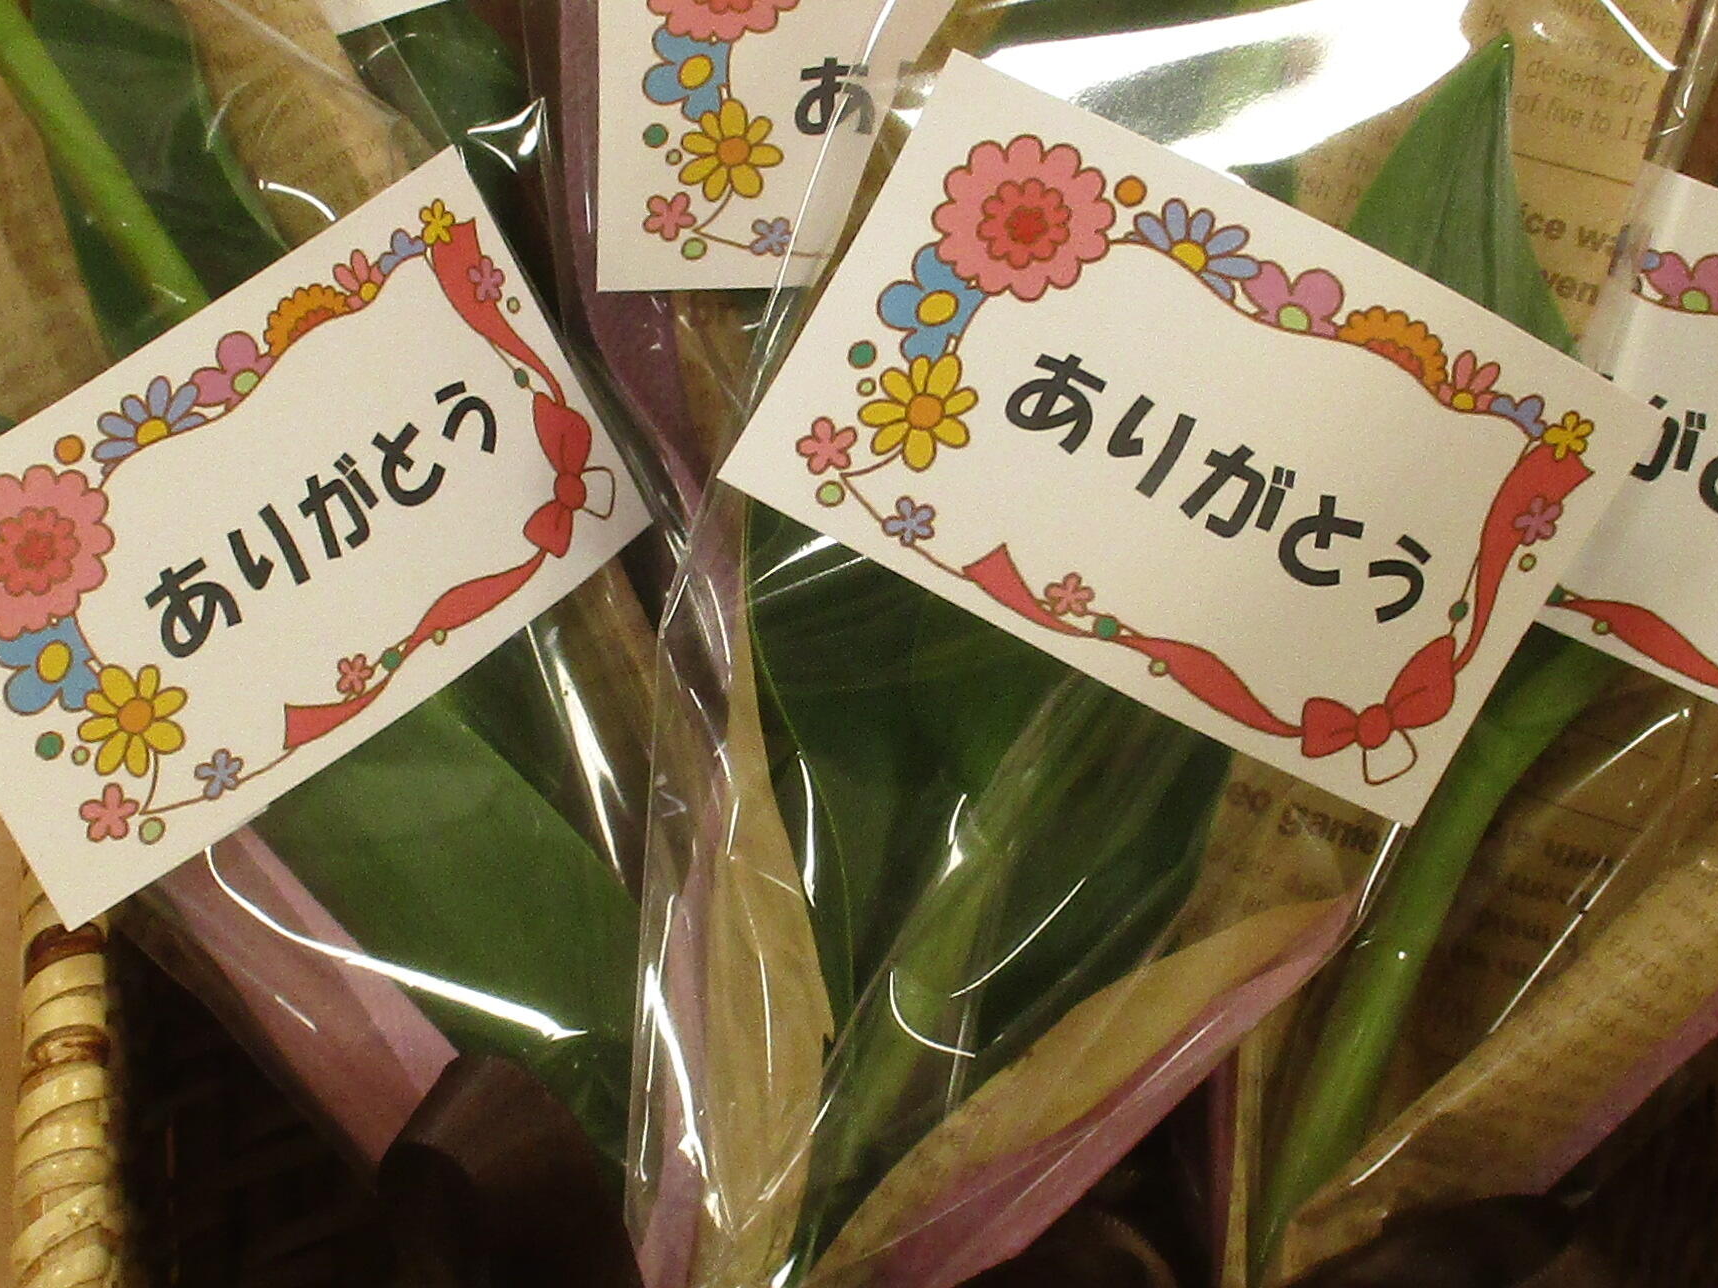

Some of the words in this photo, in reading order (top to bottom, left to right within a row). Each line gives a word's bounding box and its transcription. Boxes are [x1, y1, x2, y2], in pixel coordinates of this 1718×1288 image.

[1524, 58, 1612, 97] deserts
[1617, 78, 1646, 105] of
[1513, 91, 1541, 117] of
[1546, 99, 1584, 127] five
[1588, 109, 1613, 135] to
[1005, 353, 1432, 624] ありがとう
[145, 380, 497, 659] ありがとう
[1276, 799, 1383, 857] game
